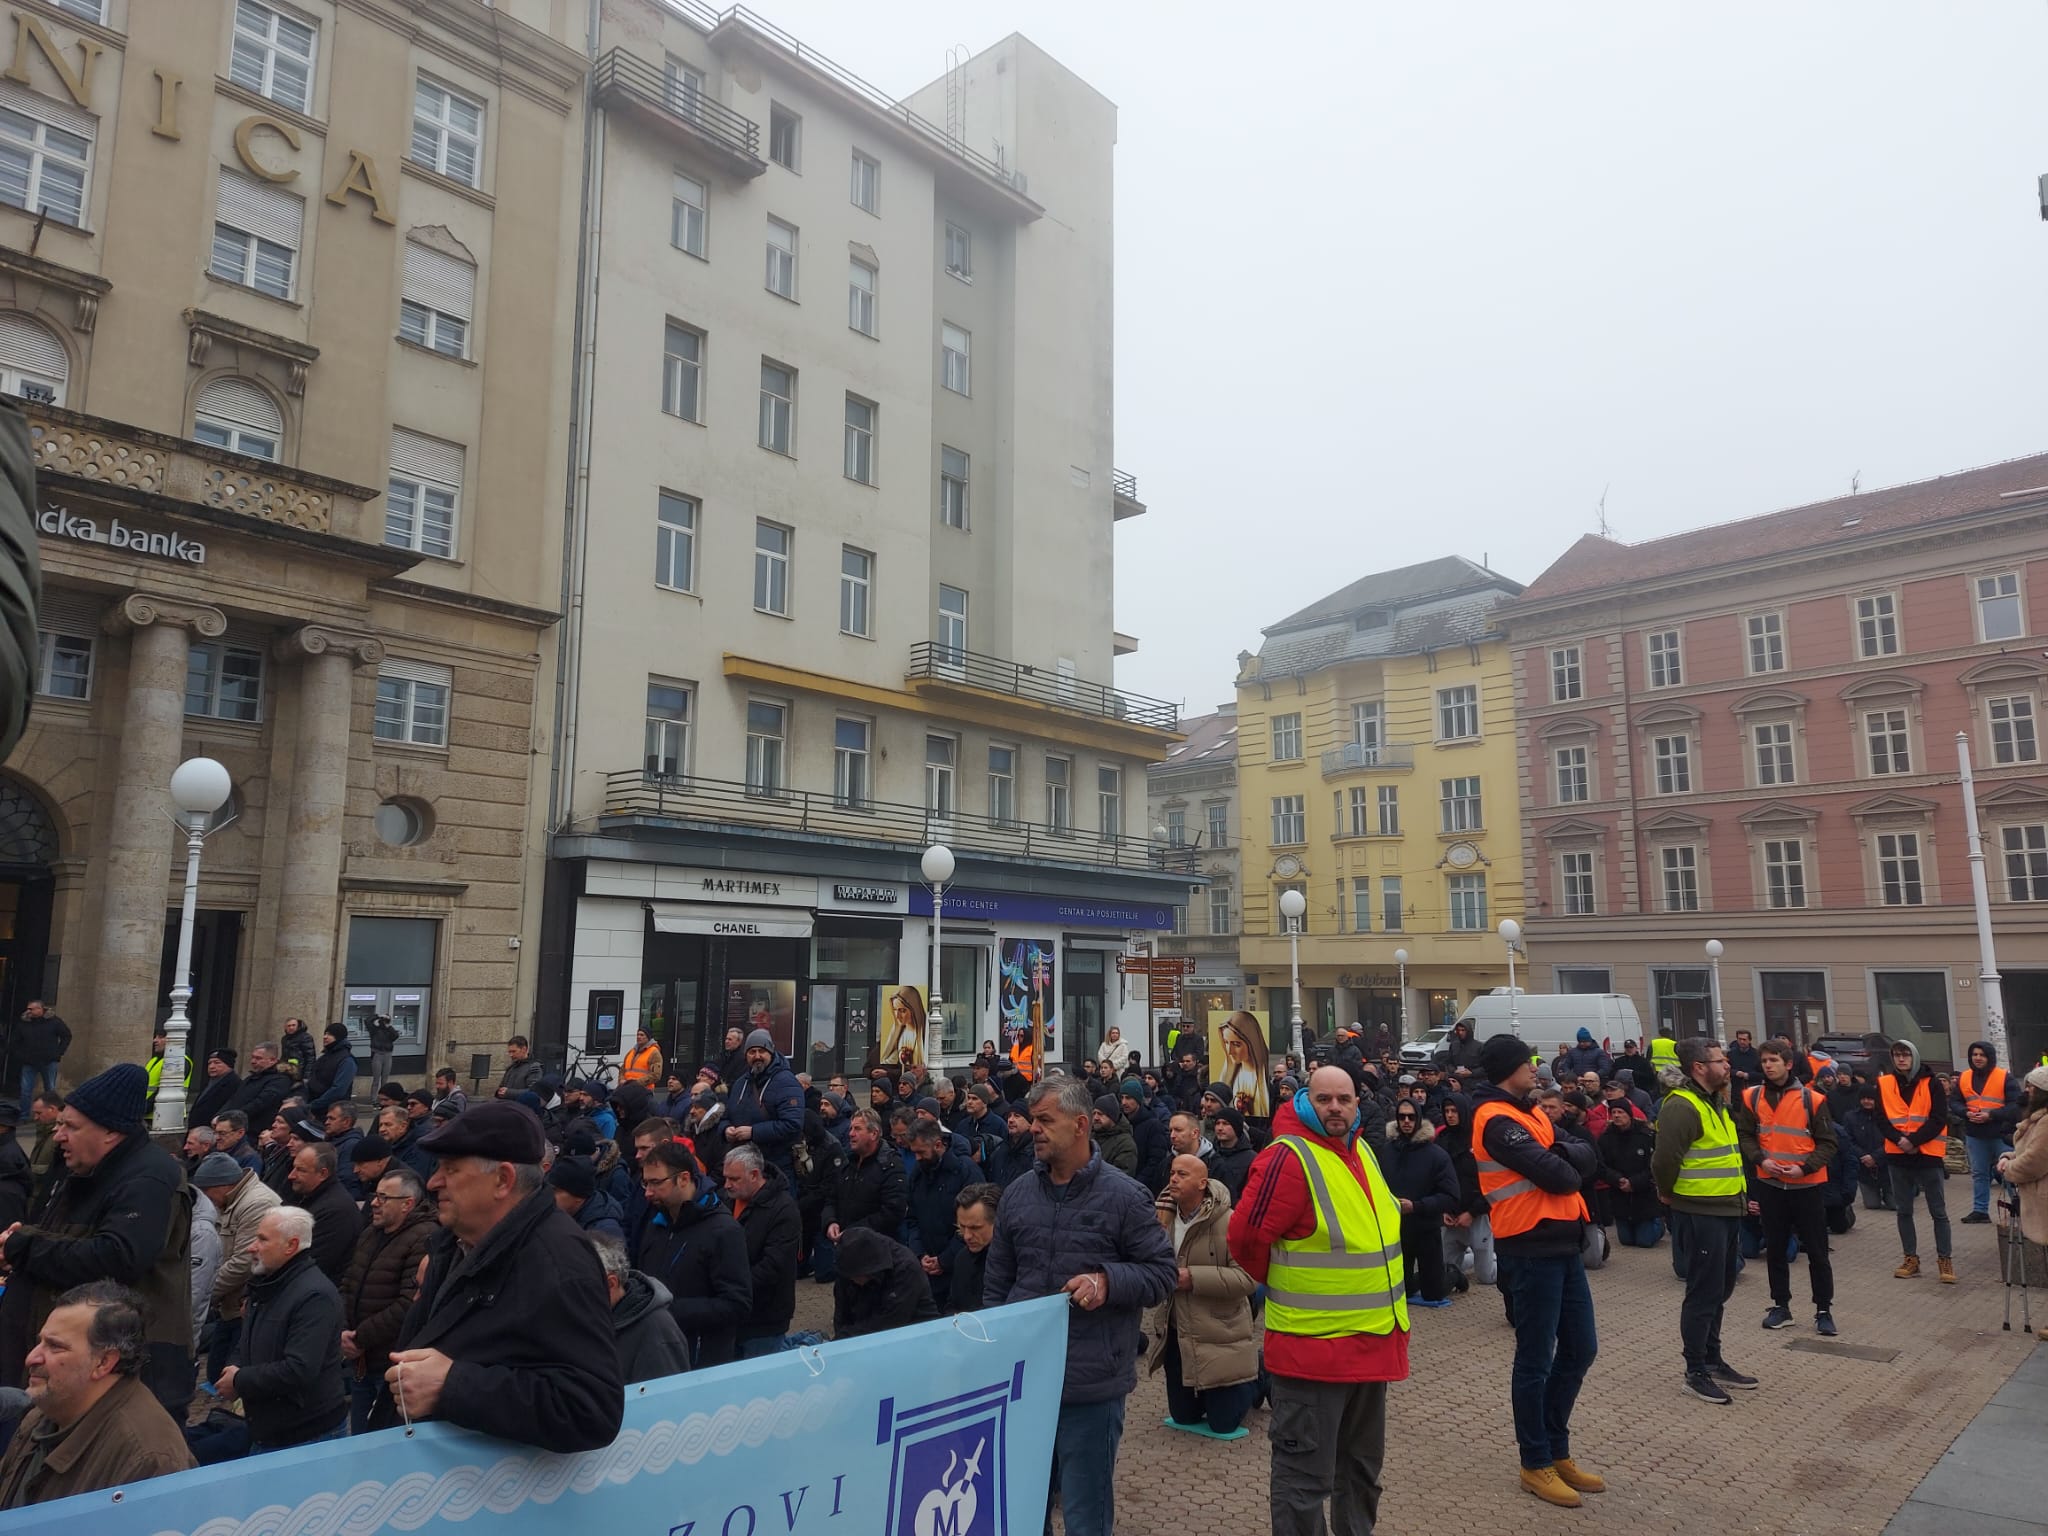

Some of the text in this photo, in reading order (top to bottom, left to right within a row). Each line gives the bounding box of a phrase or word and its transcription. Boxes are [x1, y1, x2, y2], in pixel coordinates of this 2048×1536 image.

[35, 502, 207, 564] čka banka
[702, 878, 781, 896] MARTIMEX
[838, 885, 897, 902] NAPAPIJRI
[943, 898, 998, 910] SITOR CENTER
[1058, 906, 1139, 920] CENTAR ZA POSJETITELJE
[713, 922, 761, 935] CHANEL
[931, 1498, 962, 1536] M
